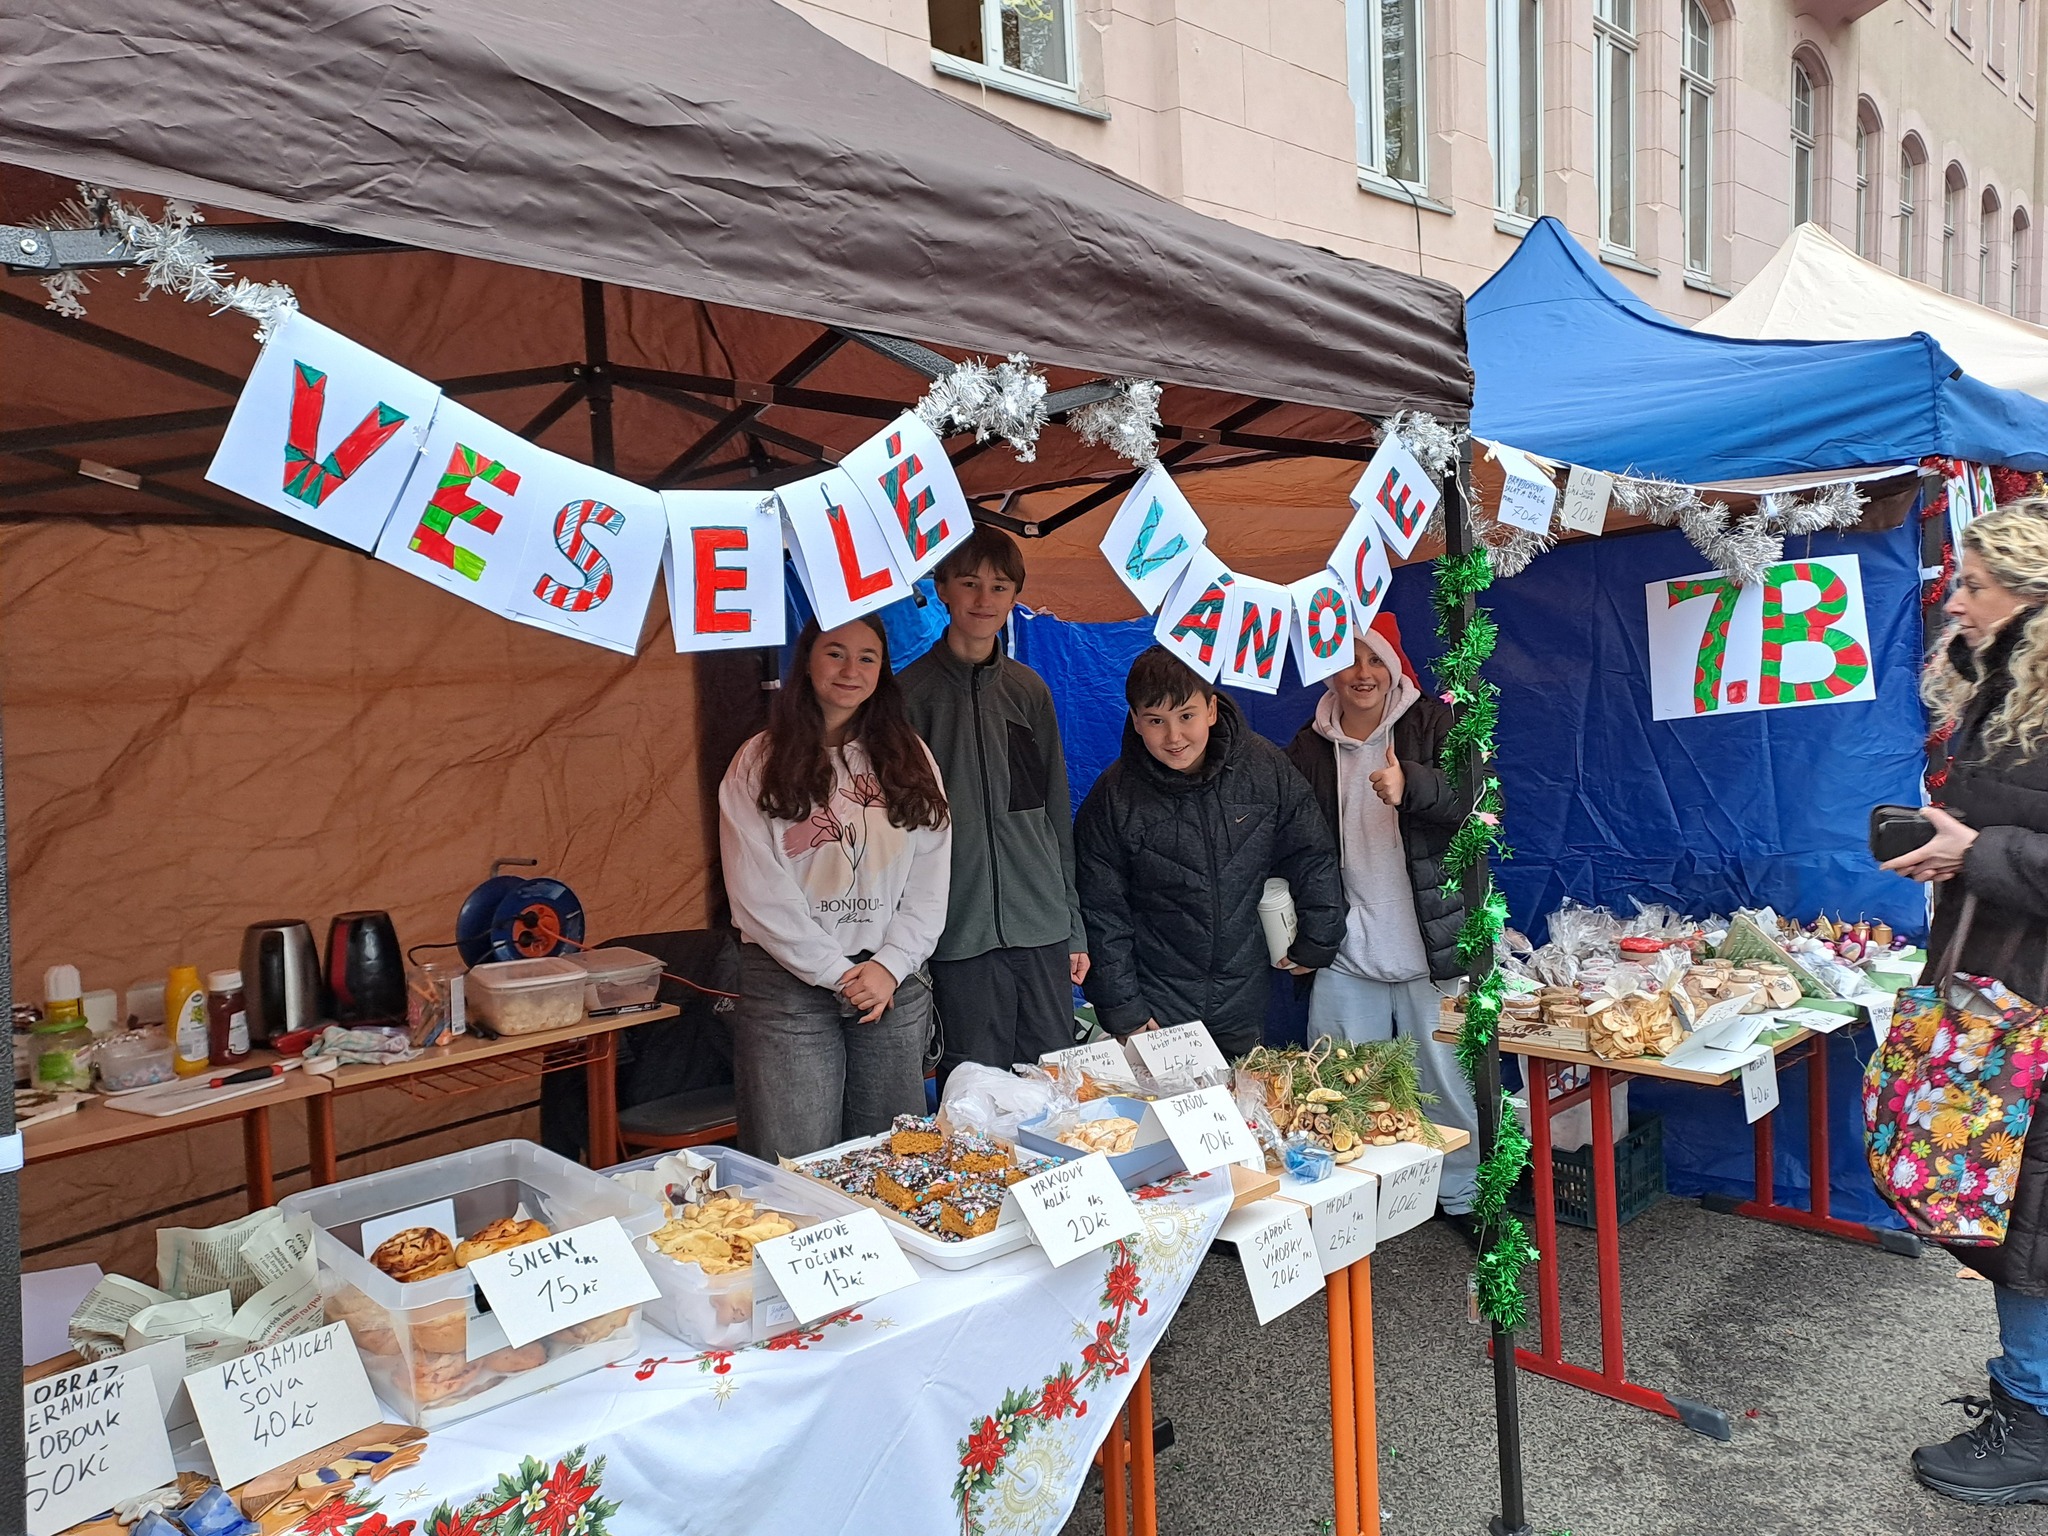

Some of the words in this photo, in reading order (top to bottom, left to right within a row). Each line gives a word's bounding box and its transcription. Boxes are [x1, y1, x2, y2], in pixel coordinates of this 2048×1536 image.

[282, 357, 949, 635] VESELÉ
[1125, 466, 1426, 679] VÁNOCE
[1667, 562, 1868, 715] 7.B
[1030, 1161, 1084, 1198] MRKVOVÝ
[507, 1237, 578, 1277] ŠNEKY
[222, 1323, 340, 1390] KERAMICKÁ
